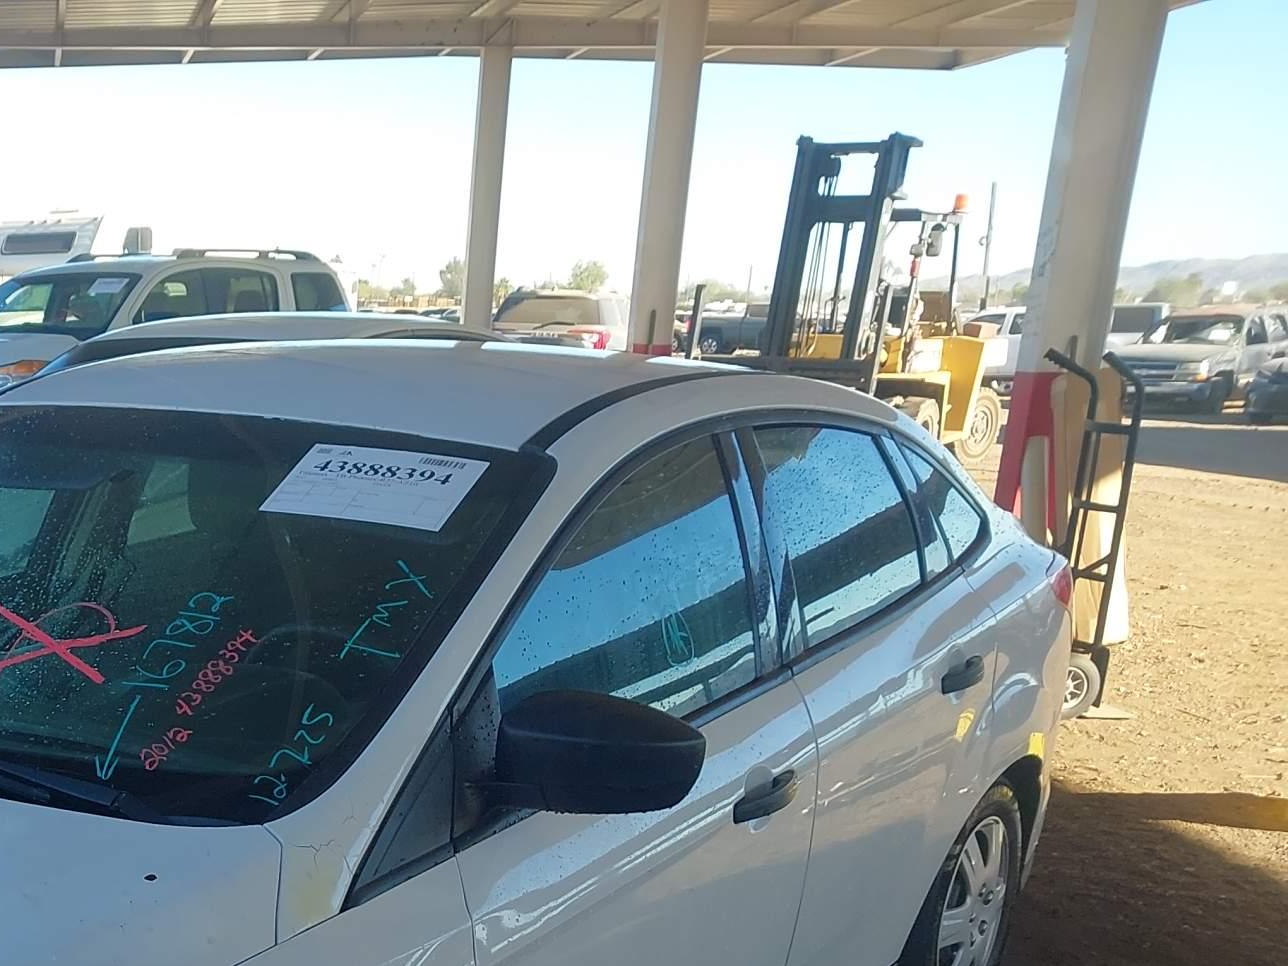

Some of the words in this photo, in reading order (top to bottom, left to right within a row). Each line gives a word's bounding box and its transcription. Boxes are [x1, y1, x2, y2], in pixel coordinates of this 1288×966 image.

[312, 458, 454, 486] 43888394
[121, 591, 235, 690] 167812
[138, 726, 193, 771] 2012
[175, 628, 261, 716] 43888394
